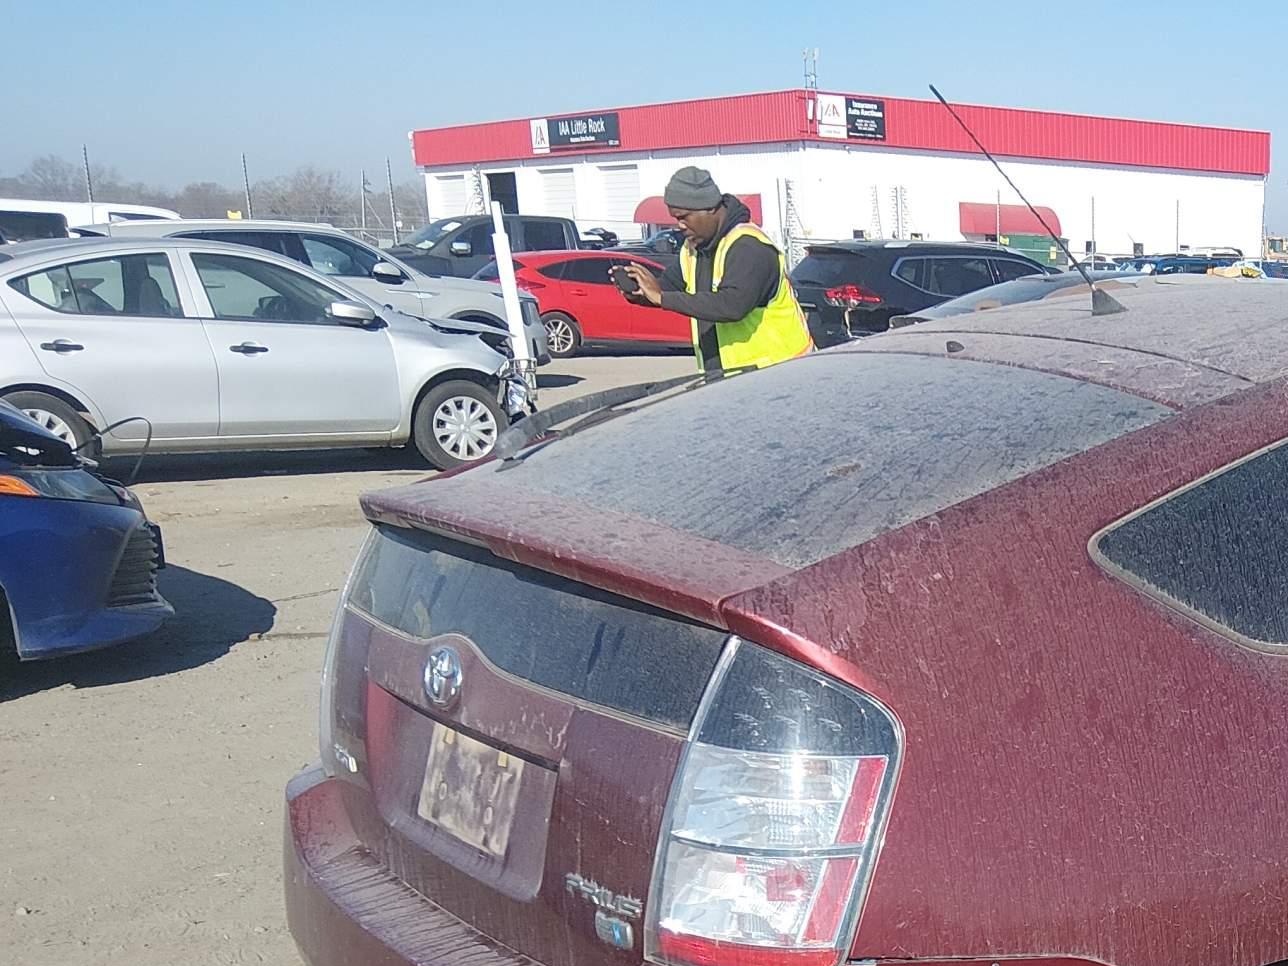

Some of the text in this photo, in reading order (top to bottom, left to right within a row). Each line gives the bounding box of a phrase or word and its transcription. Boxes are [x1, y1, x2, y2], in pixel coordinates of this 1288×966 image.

[559, 117, 606, 136] IAA Little Rock
